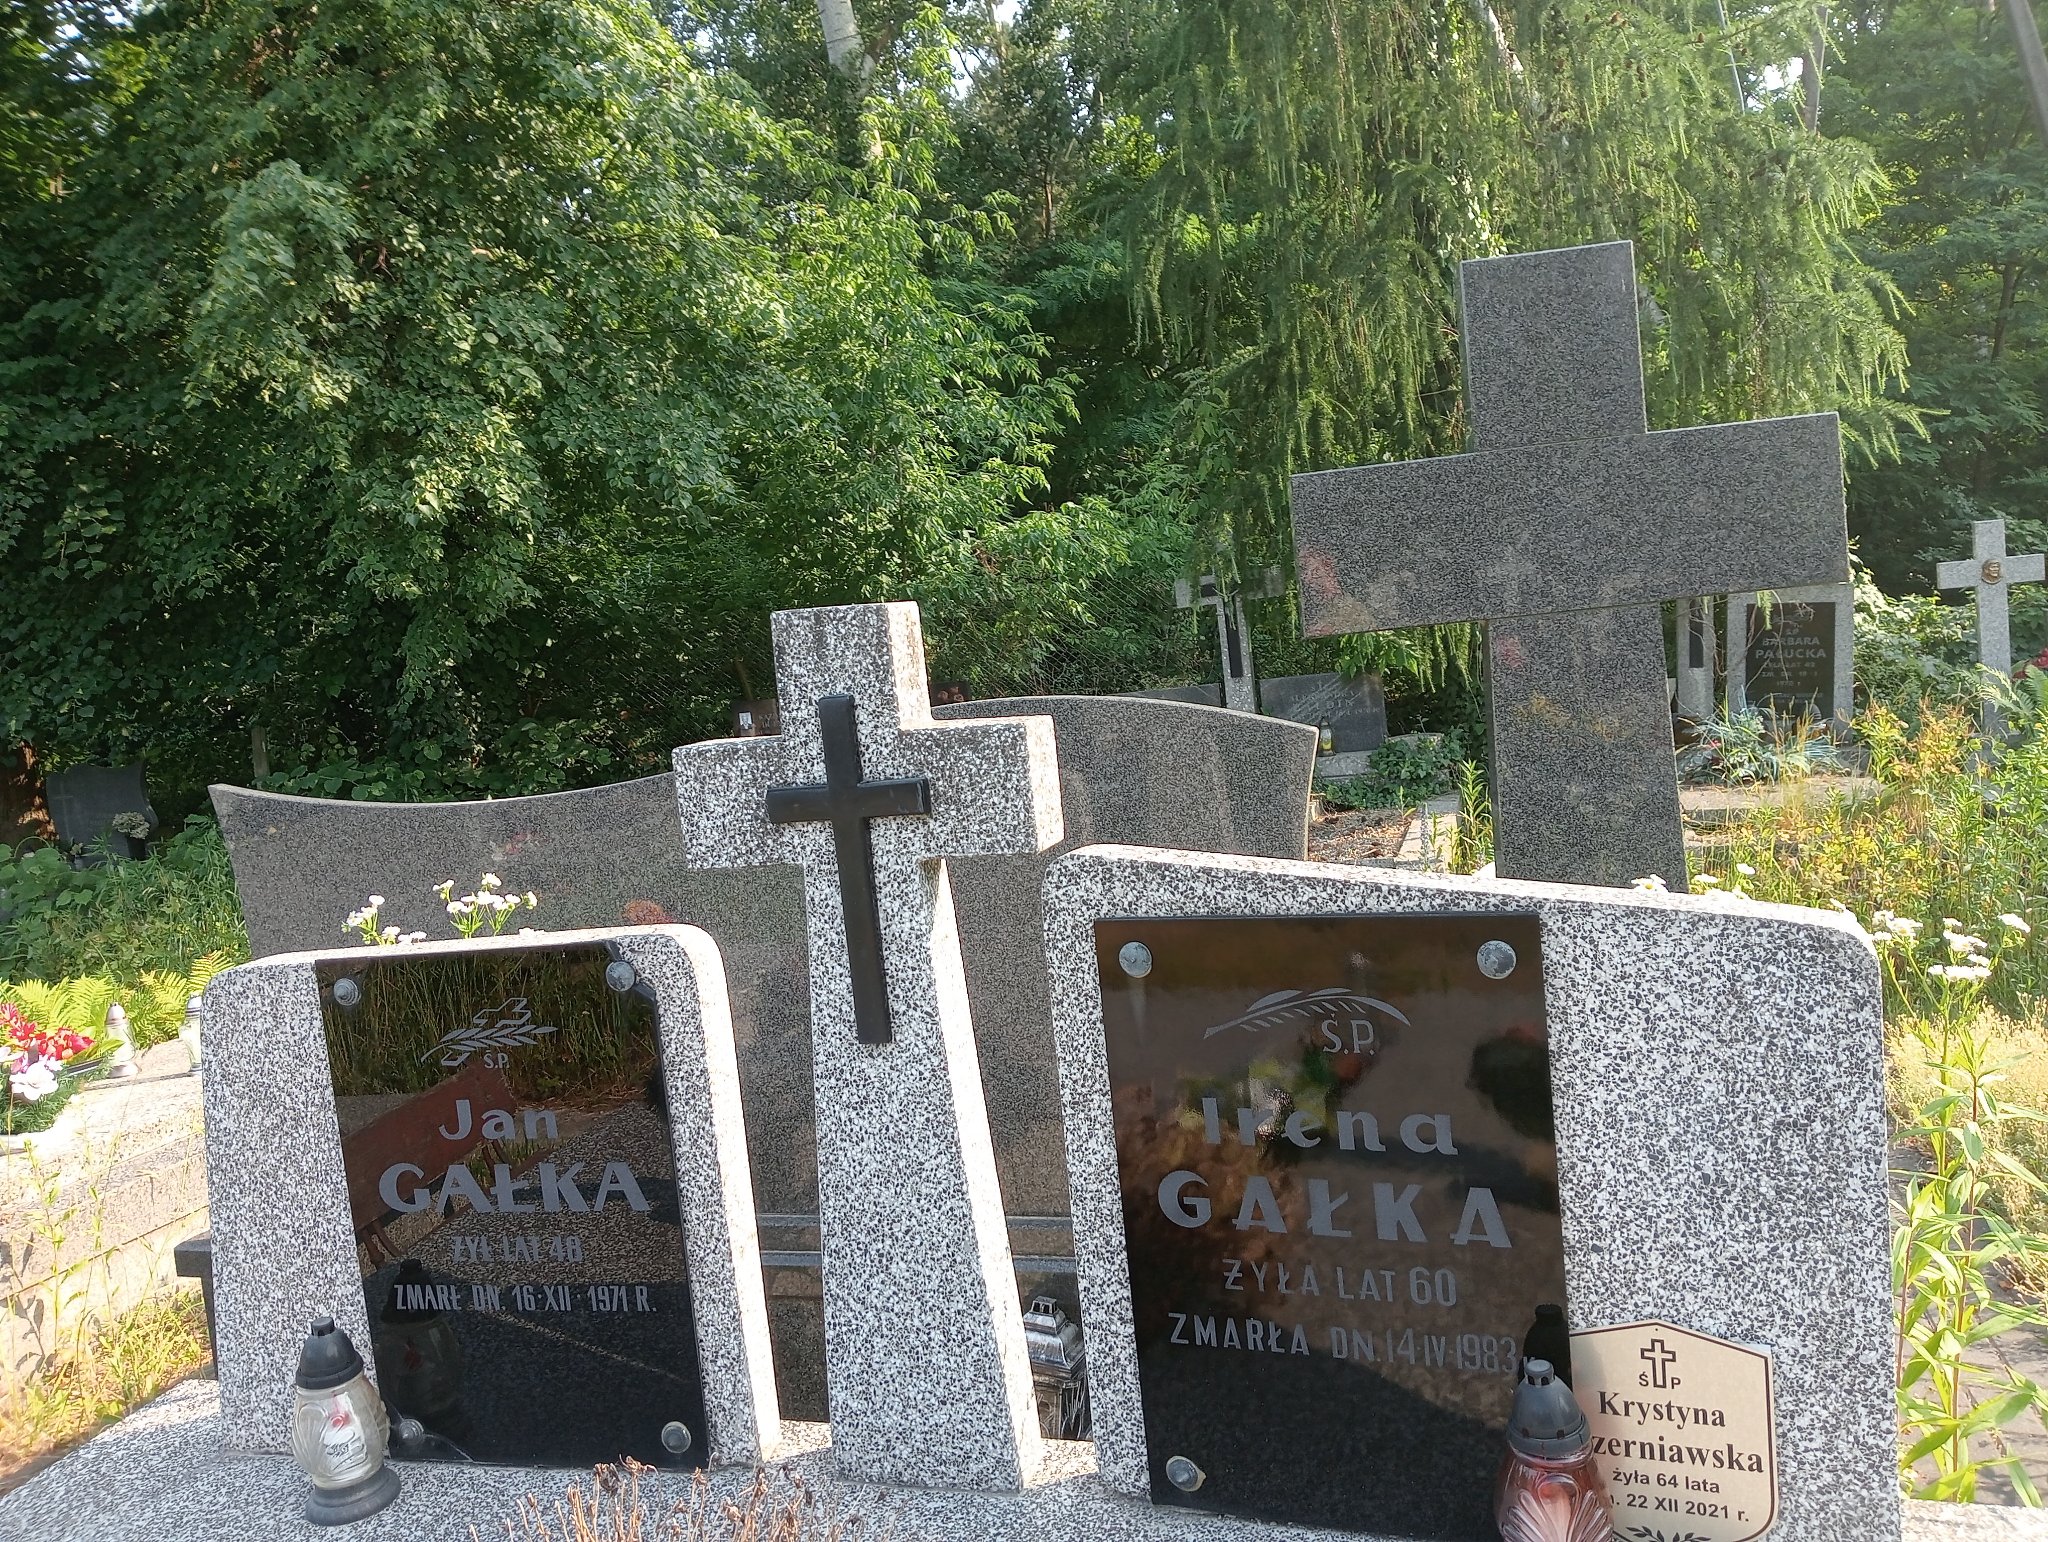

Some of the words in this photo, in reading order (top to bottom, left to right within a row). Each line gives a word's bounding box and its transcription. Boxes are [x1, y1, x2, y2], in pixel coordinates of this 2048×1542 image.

[1763, 637, 1820, 646] BARBARA
[438, 1099, 559, 1141] Jan
[1202, 1097, 1458, 1156] Irena
[378, 1161, 651, 1213] GAŁKA
[1158, 1170, 1512, 1248] GAŁKA
[500, 1235, 541, 1263] LAT
[394, 1284, 461, 1311] ZMARŁ
[635, 1285, 657, 1313] R.
[1335, 1266, 1396, 1302] LAT
[1409, 1266, 1457, 1307] 60
[1168, 1312, 1310, 1356] ZMARŁA
[1597, 1391, 1726, 1429] Krystyna
[1591, 1435, 1764, 1474] zerniawska
[1612, 1467, 1650, 1486] żyła
[1656, 1473, 1678, 1488] 64
[1685, 1476, 1720, 1493] lata
[1626, 1493, 1648, 1509] 22
[1654, 1496, 1679, 1512] XII
[1685, 1501, 1729, 1519] 2021
[1737, 1508, 1750, 1522] r.
